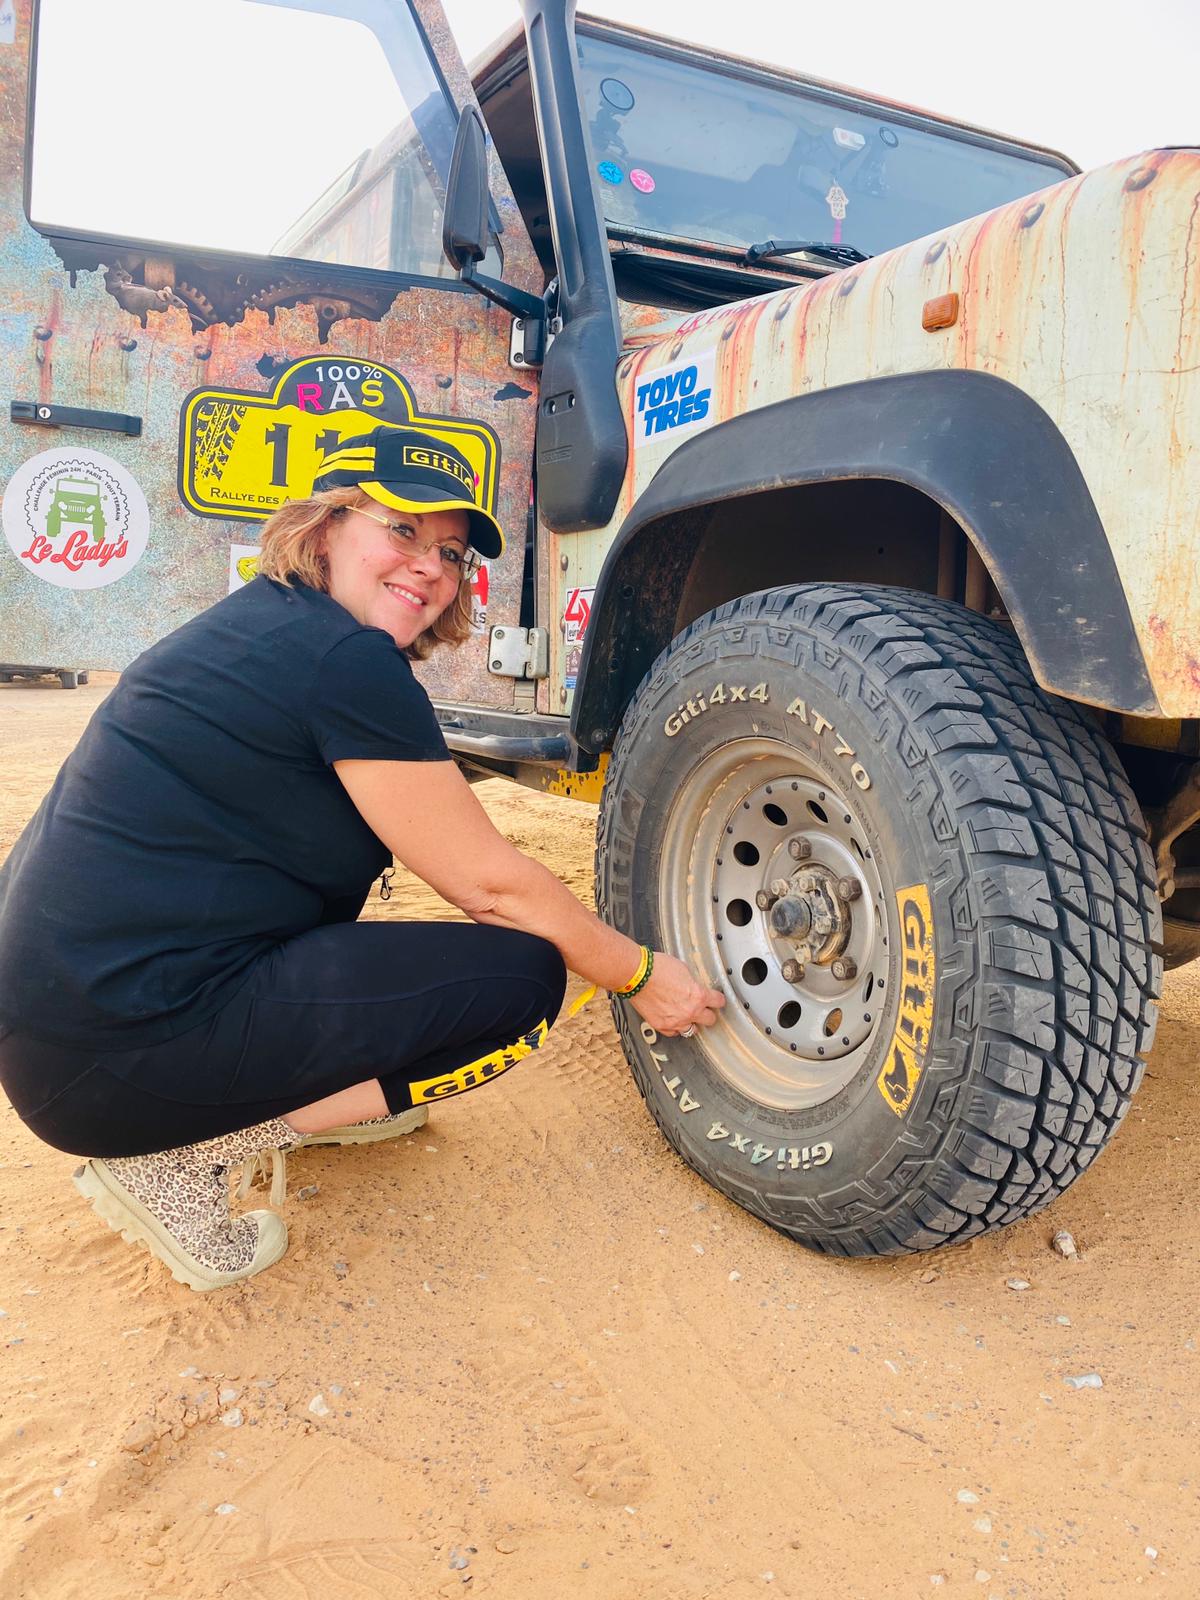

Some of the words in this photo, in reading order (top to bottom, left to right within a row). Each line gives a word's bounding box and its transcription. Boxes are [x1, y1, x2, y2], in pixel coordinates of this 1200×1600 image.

[297, 380, 385, 411] RAS
[316, 365, 383, 382] 100%
[637, 365, 698, 412] TOYO
[644, 388, 711, 437] TIRES
[410, 451, 459, 475] Giti
[33, 480, 48, 511] CHALLENGE
[46, 467, 69, 481] FEMININ
[85, 469, 103, 481] PARIS
[104, 481, 116, 498] TOUT
[113, 495, 121, 521] TERRAIN
[21, 535, 53, 564] Le
[50, 530, 129, 572] Lady's
[901, 899, 928, 1043] Giti
[422, 1053, 516, 1098] Giti
